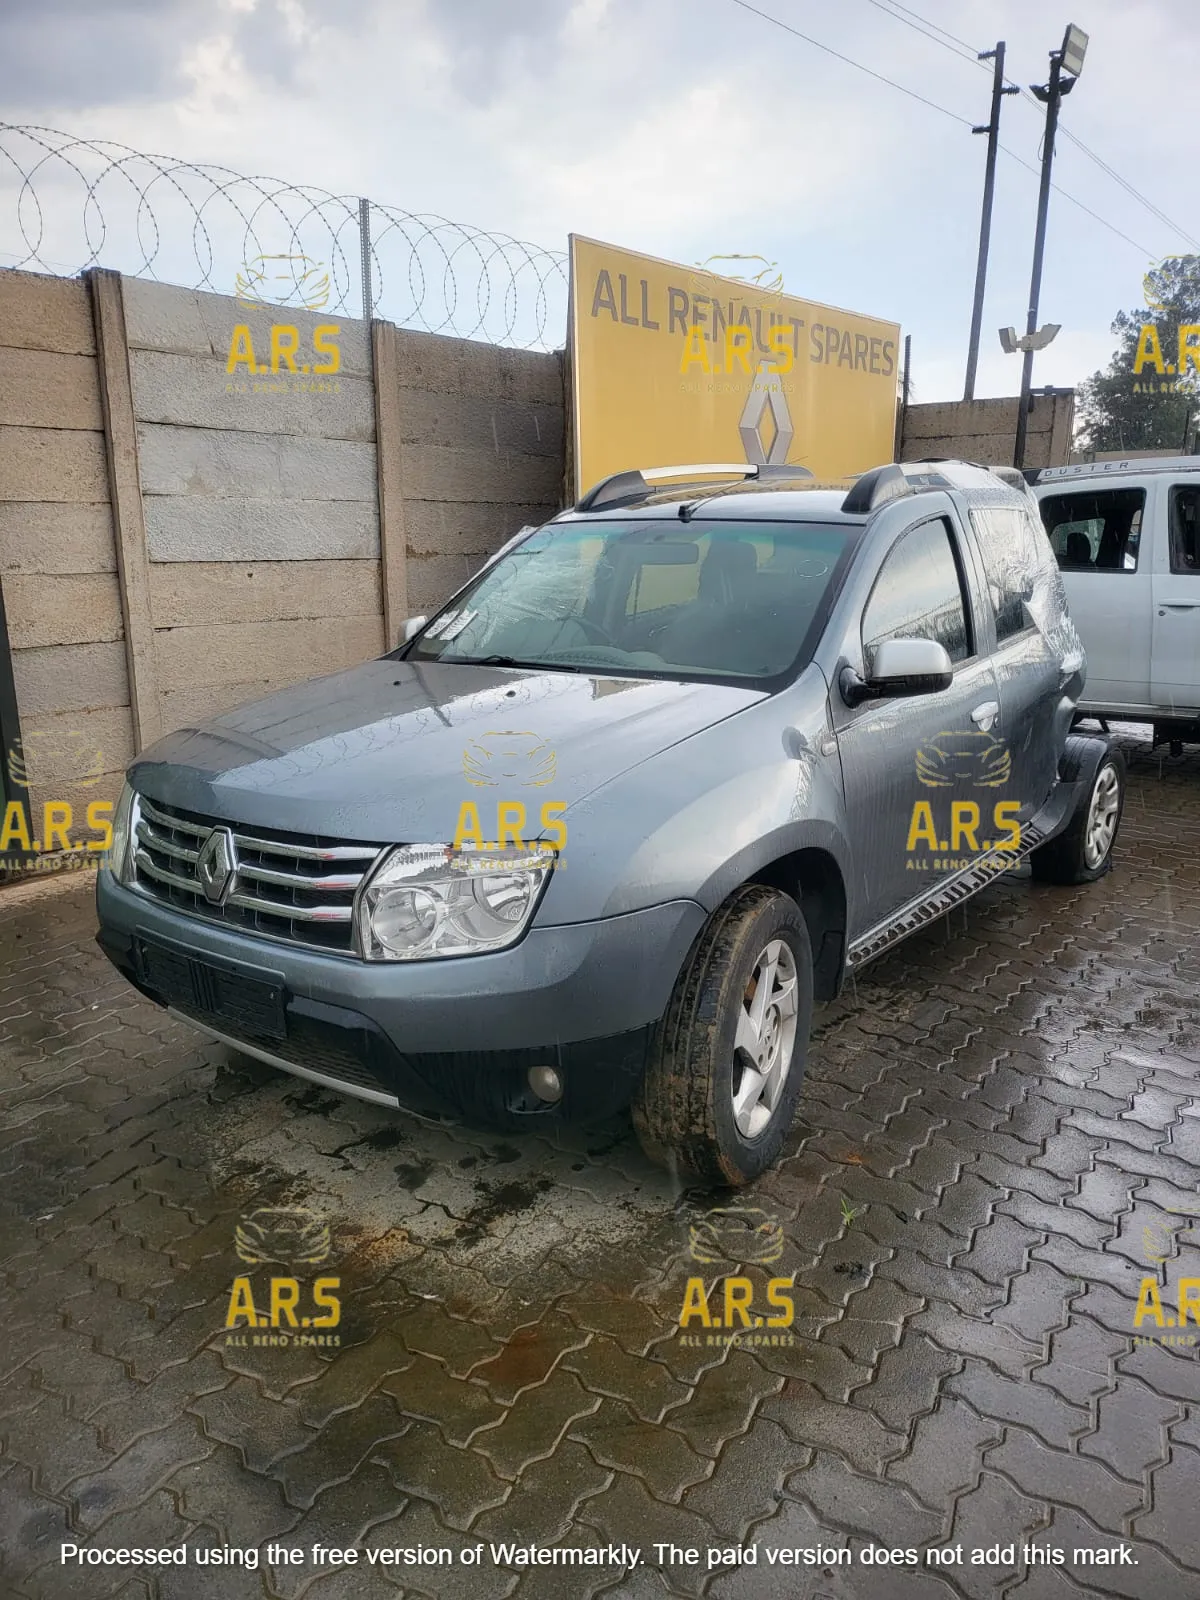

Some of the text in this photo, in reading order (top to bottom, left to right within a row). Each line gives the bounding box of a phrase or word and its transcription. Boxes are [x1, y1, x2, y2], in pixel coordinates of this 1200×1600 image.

[591, 268, 895, 377] ALL RENAULT SPARES
[1044, 461, 1129, 477] DUSTER
